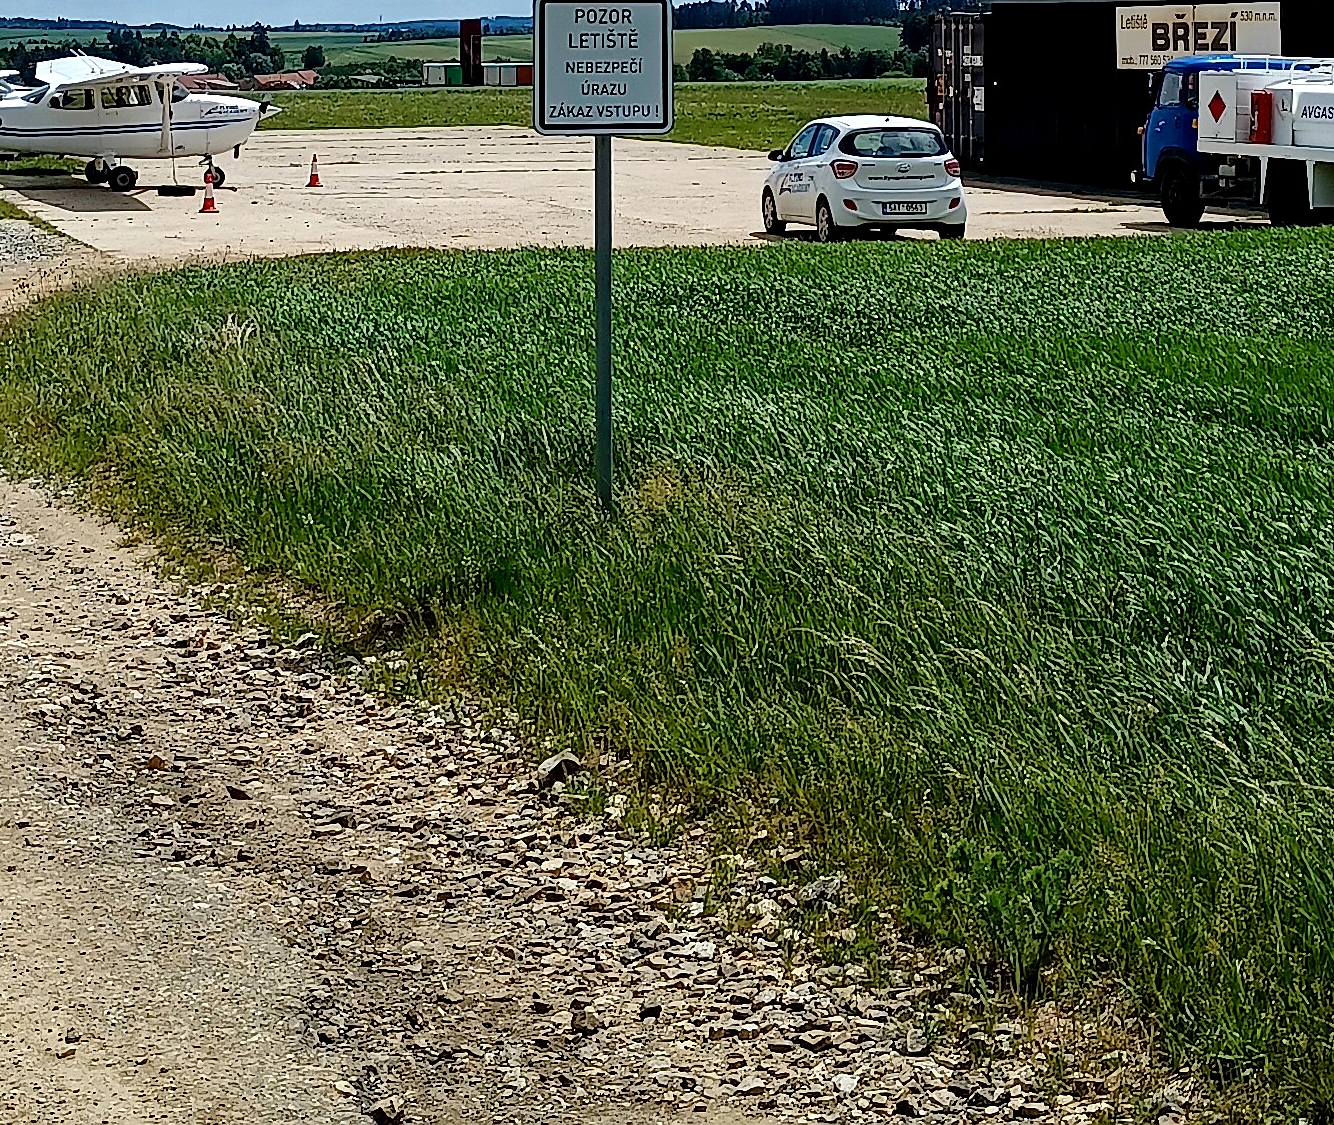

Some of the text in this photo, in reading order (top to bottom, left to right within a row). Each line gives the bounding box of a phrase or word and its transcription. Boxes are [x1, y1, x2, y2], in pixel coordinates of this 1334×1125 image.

[574, 8, 632, 24] POZOR
[1120, 13, 1148, 30] Letiště
[568, 29, 638, 49] LETIŠTĚ
[1151, 12, 1238, 52] BŘEZÍ
[565, 58, 643, 74] NEBEZPEČÍ
[581, 79, 627, 96] ÚRAZU
[549, 102, 593, 118] ZÁKAZ
[597, 105, 651, 118] VSTUPU
[1301, 105, 1334, 120] AVGAS
